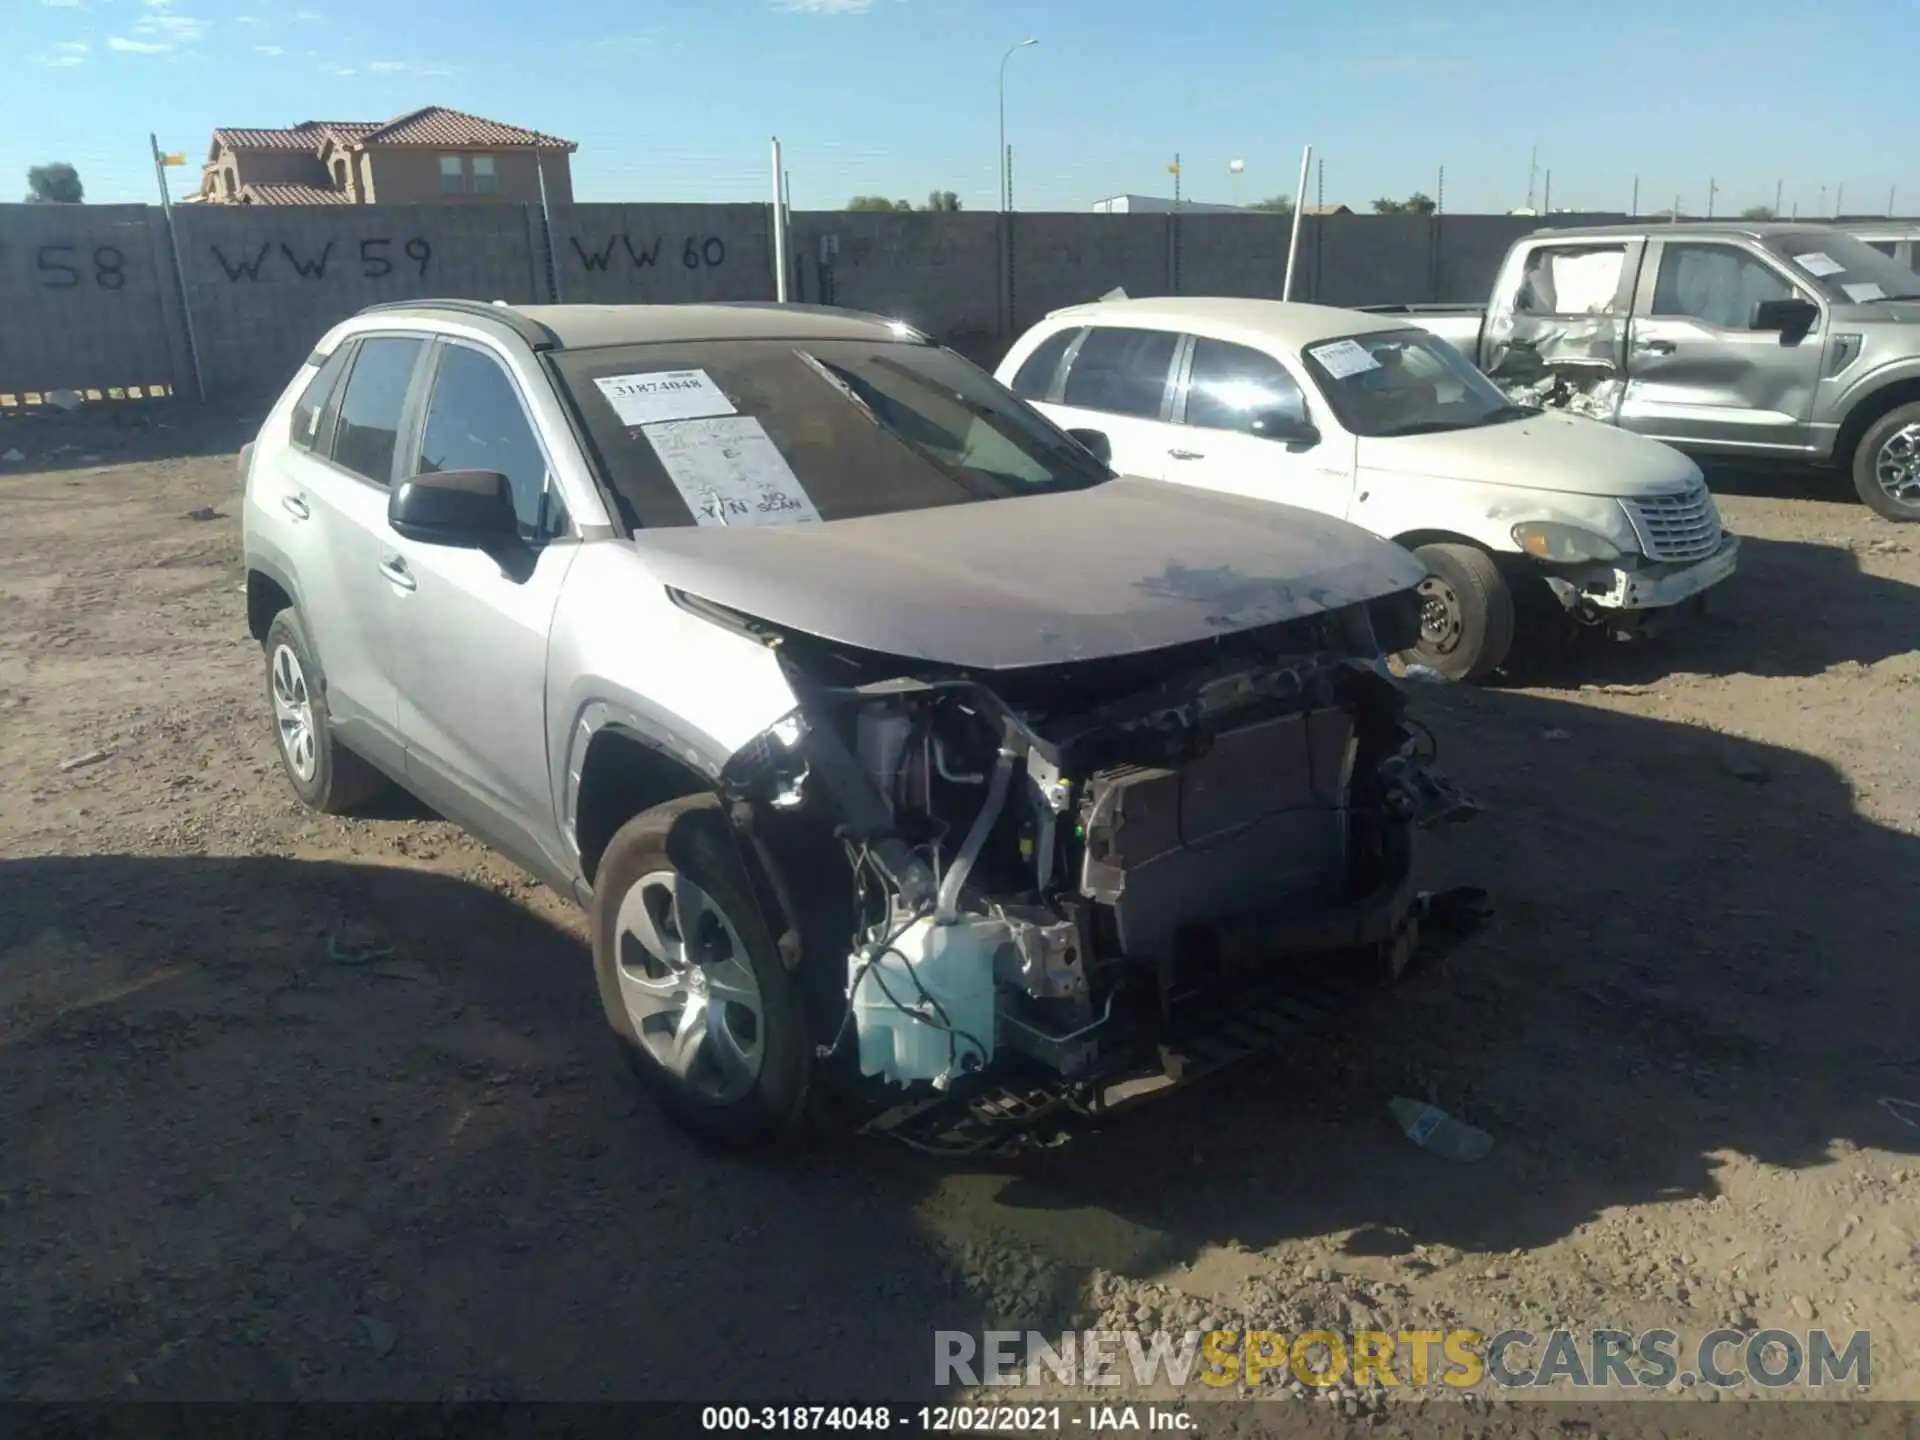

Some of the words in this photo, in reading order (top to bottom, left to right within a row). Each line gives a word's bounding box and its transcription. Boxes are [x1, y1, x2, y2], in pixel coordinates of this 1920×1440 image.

[37, 245, 127, 290] 58
[210, 241, 333, 283] WW
[360, 237, 431, 278] 59
[569, 233, 662, 272] WW
[683, 236, 725, 270] 60
[614, 379, 702, 397] 31874048
